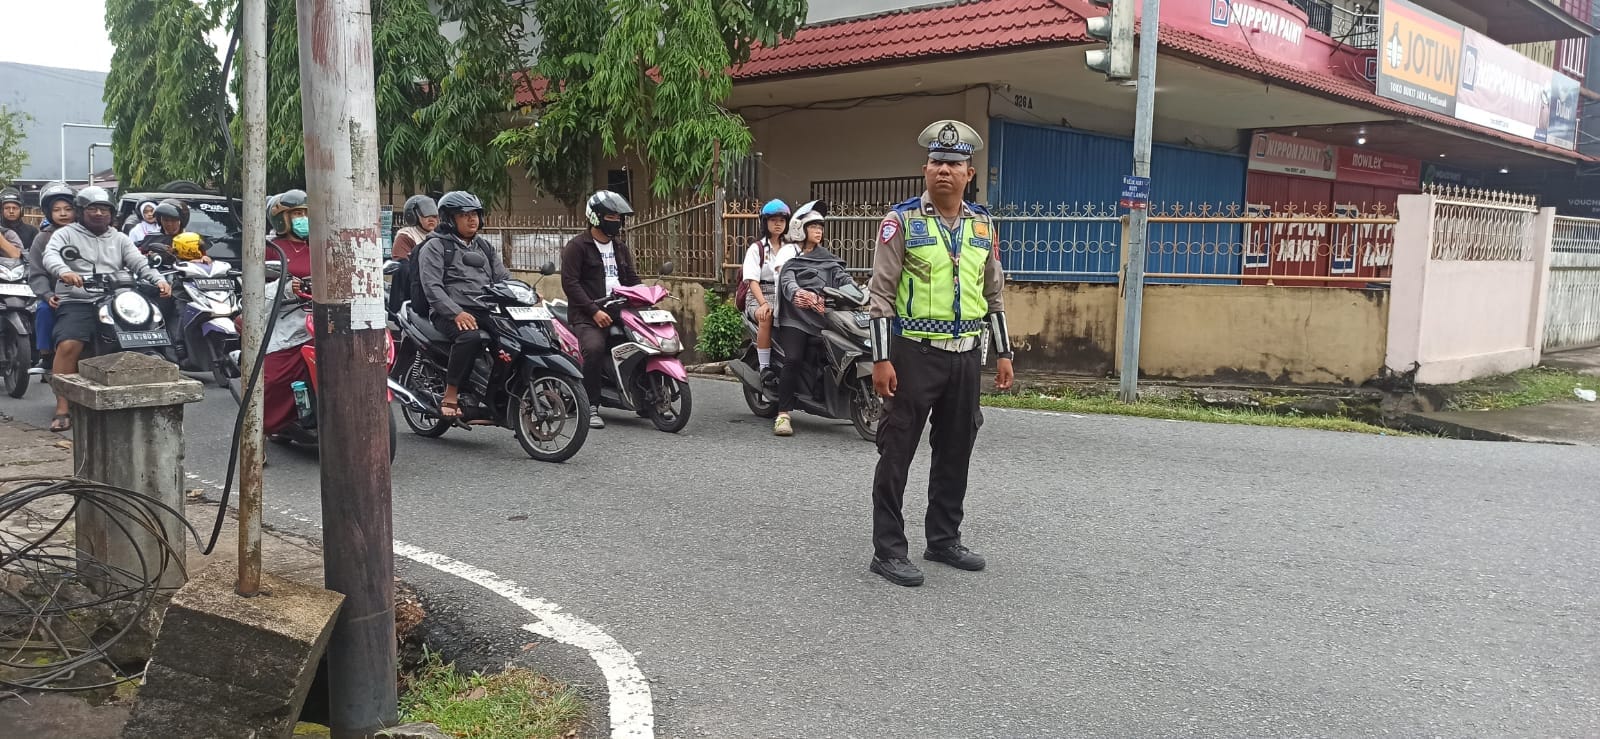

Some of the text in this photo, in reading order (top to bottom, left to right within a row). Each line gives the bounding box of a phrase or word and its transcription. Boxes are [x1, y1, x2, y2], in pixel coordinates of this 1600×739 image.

[1230, 2, 1302, 46] NIPPON PAINT
[1403, 31, 1457, 85] JOTUN
[1266, 140, 1322, 163] NIPPON PAINT
